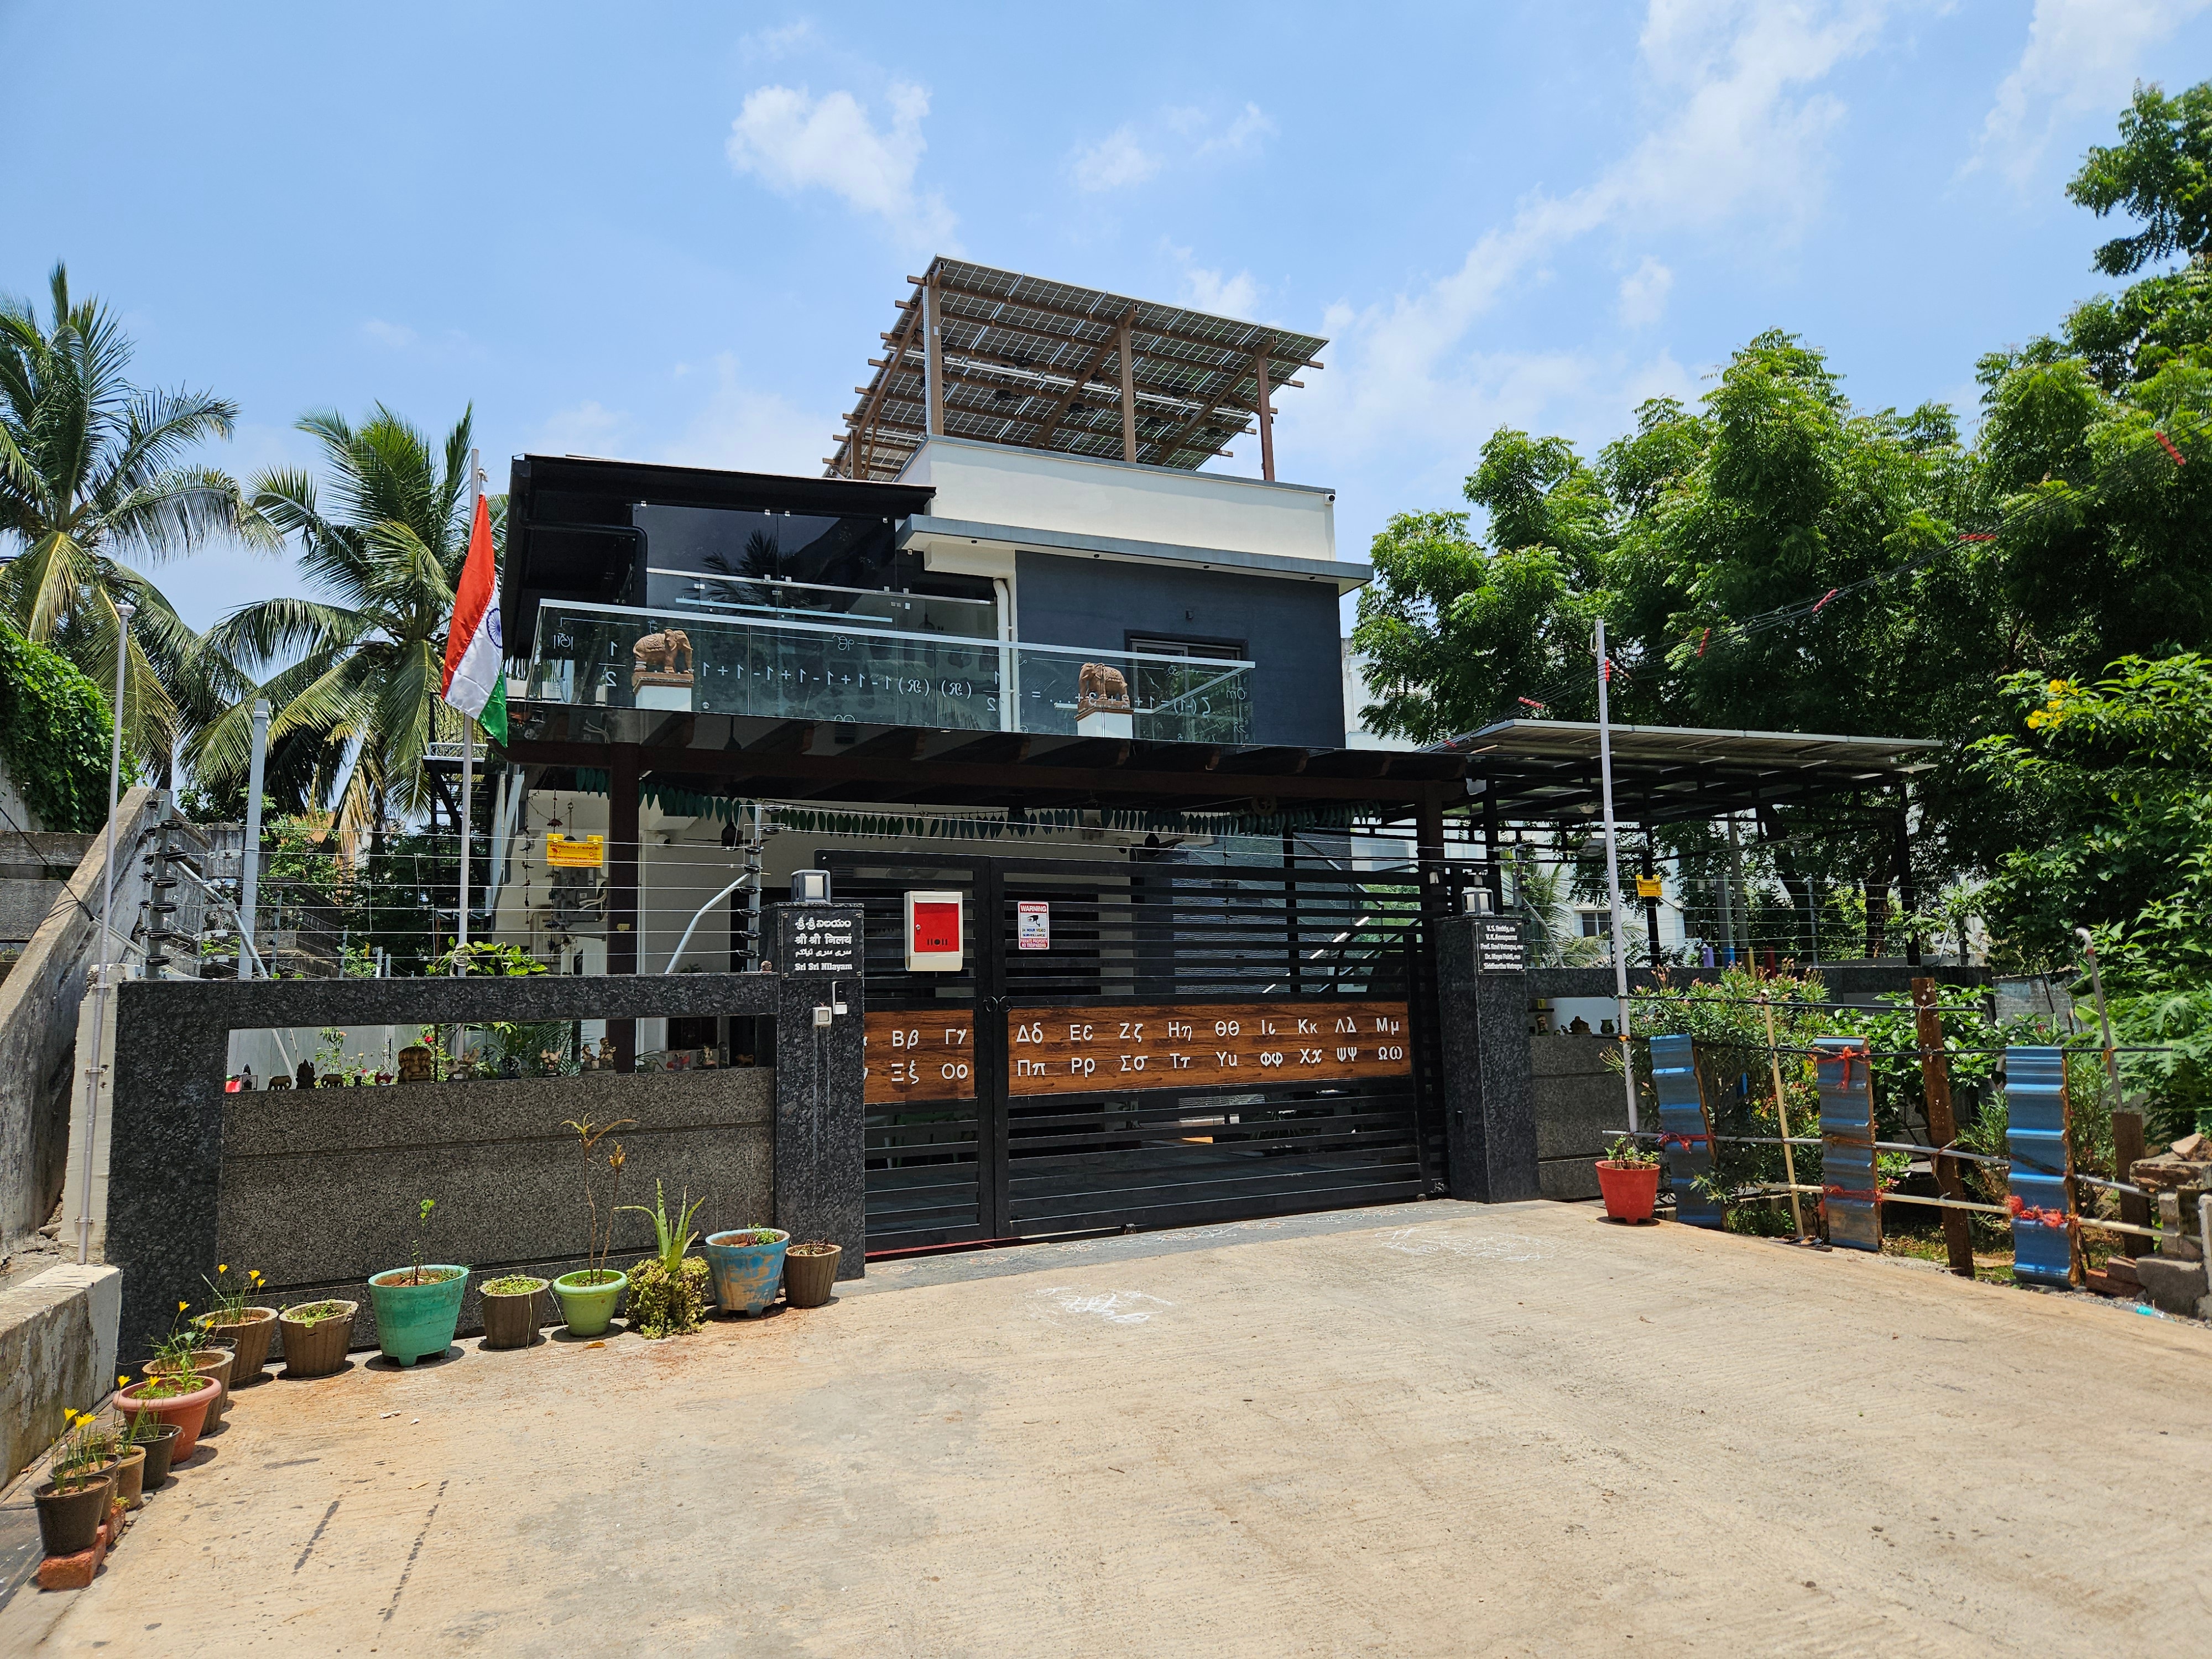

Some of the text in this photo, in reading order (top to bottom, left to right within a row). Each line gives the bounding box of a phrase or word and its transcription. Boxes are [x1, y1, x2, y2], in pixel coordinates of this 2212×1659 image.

[794, 933, 852, 945] श्री श्री निलयं
[795, 963, 806, 971] Sri
[821, 963, 853, 972] Nilayam
[1016, 1022, 1043, 1044] Δδ
[1018, 1060, 1045, 1076] Ππ
[1120, 1055, 1148, 1072] Σσ
